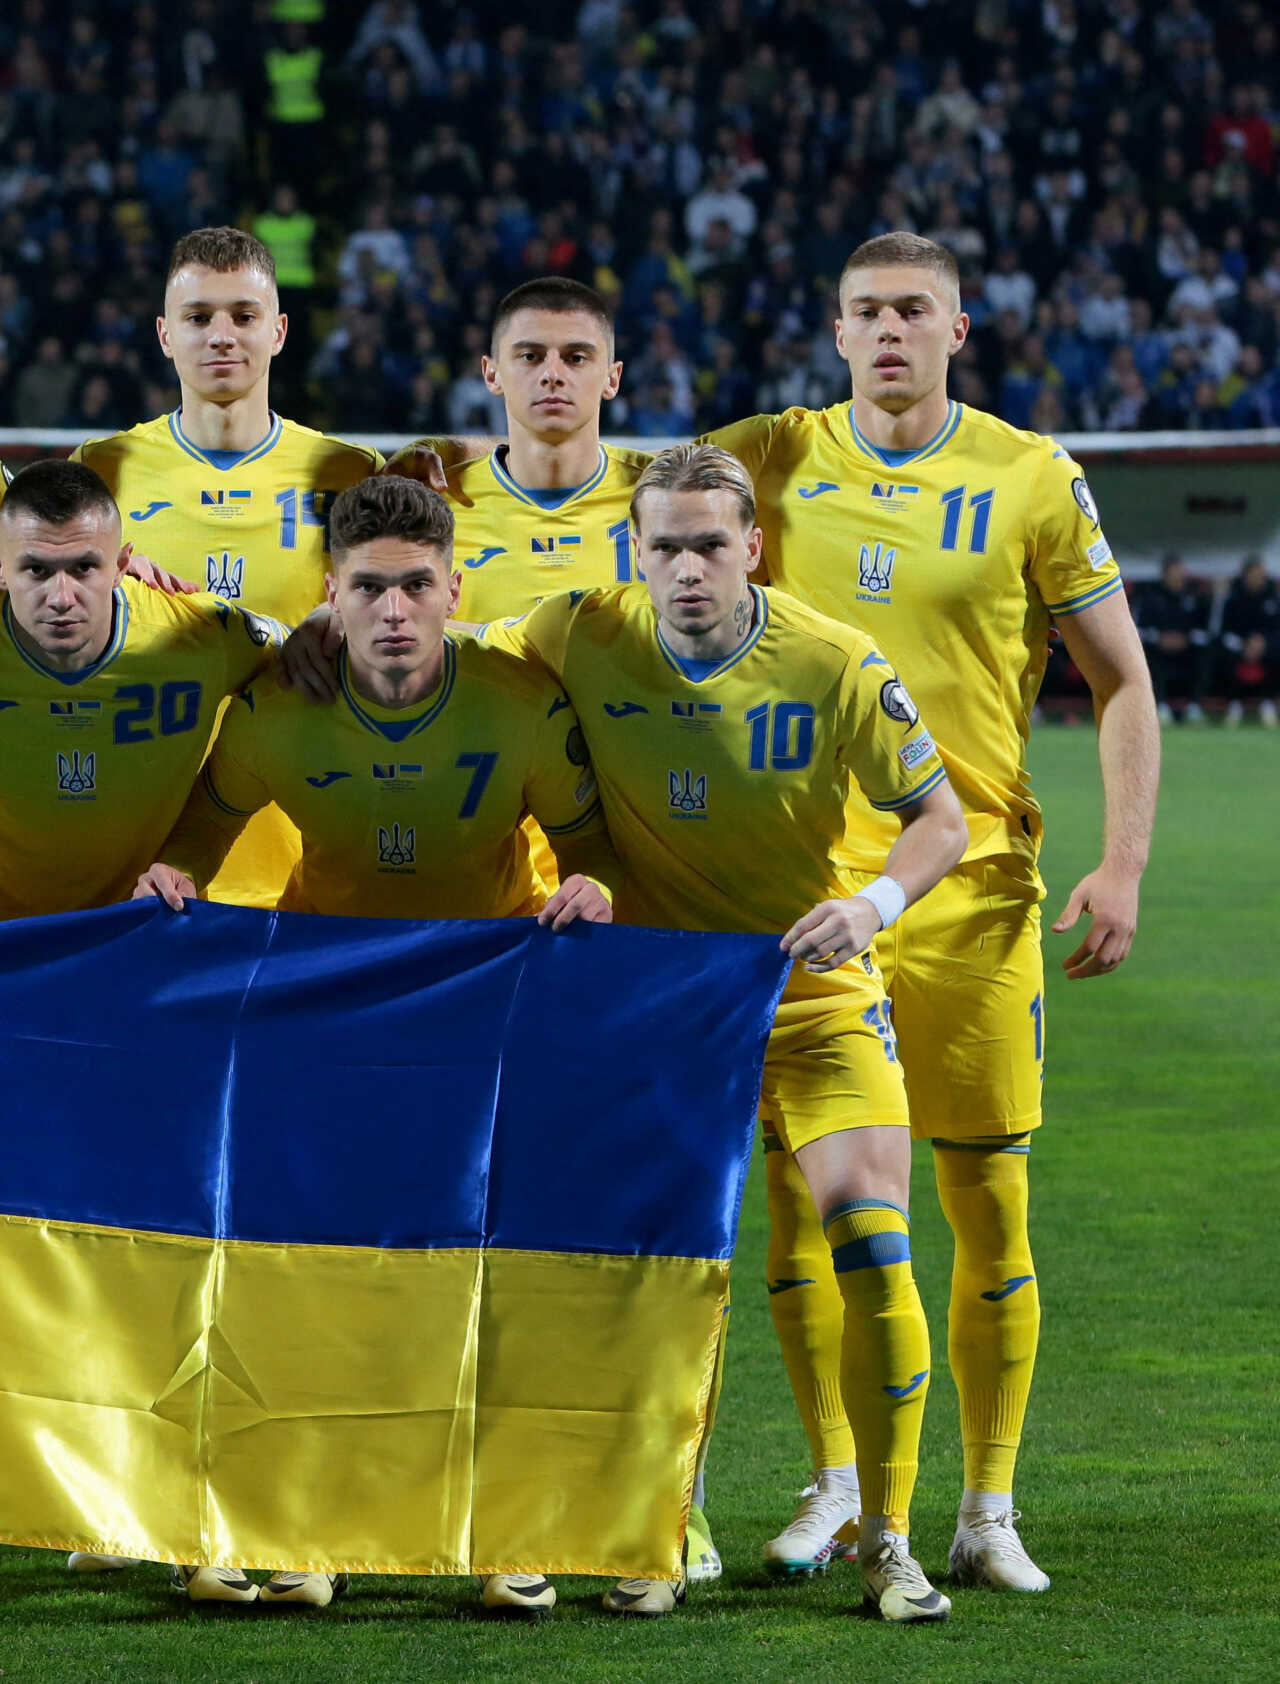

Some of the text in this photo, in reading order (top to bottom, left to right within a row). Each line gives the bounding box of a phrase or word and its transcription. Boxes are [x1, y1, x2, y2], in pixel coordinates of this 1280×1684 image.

[939, 484, 997, 554] 11
[855, 592, 892, 605] UKRAINE
[113, 681, 202, 744] 20
[745, 699, 815, 771] 10
[455, 751, 500, 820] 7
